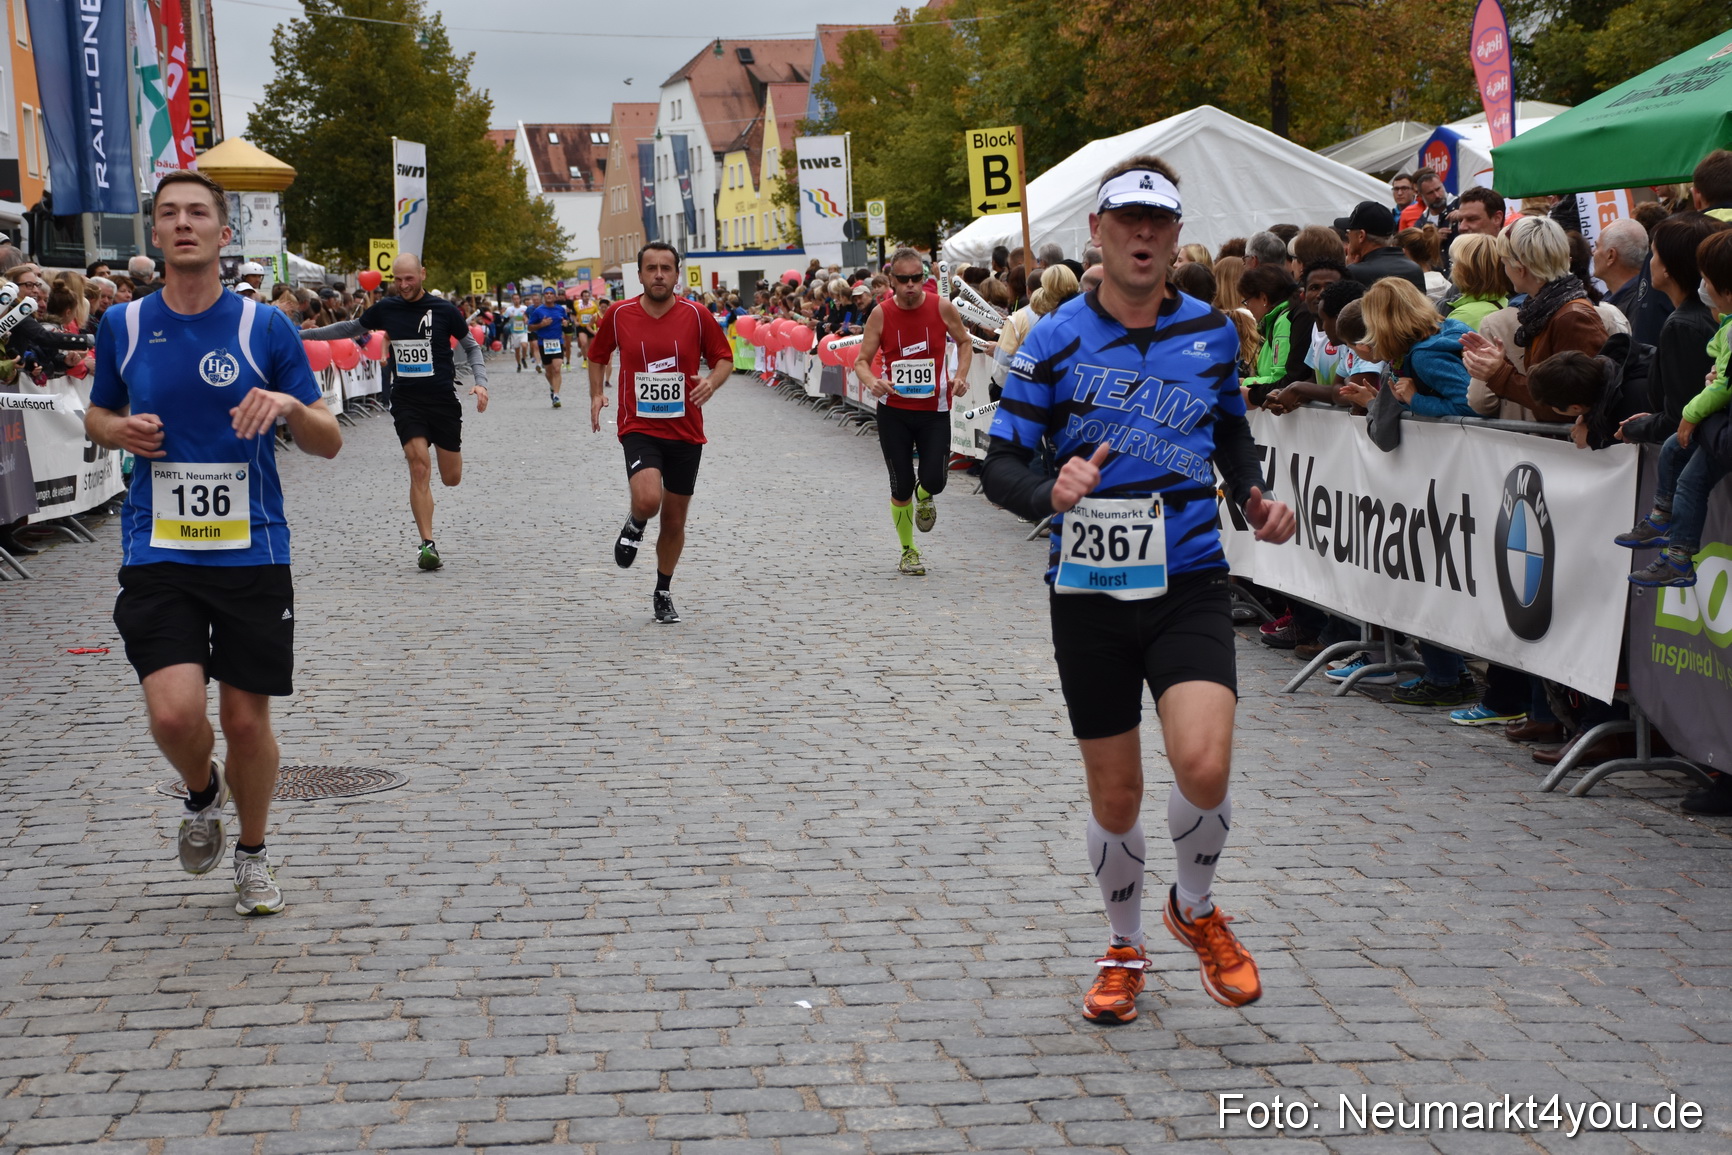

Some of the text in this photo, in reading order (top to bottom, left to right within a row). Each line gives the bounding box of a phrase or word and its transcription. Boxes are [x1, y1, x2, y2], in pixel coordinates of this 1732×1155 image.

[188, 70, 210, 145] HOT
[973, 130, 1017, 149] Block
[982, 154, 1012, 196] B
[373, 241, 394, 249] Block
[377, 252, 391, 271] C
[475, 279, 483, 289] D
[690, 271, 699, 283] D
[941, 276, 949, 293] BMW
[0, 315, 18, 334] BM
[397, 348, 428, 363] 2599
[896, 368, 932, 384] 2199
[640, 383, 681, 401] 2568
[906, 386, 922, 394] Peter
[6, 399, 55, 411] Laufsport
[1072, 363, 1208, 435] TEAM
[651, 404, 669, 412] Adolf
[154, 470, 232, 480] PARTL Neumarkt
[172, 484, 231, 517] 136
[1503, 468, 1549, 528] BMW
[1091, 510, 1144, 519] Neumarkt
[180, 525, 221, 538] Martin
[1290, 452, 1476, 598] Neumarkt
[1071, 521, 1153, 562] 2367
[1089, 571, 1128, 587] Horst
[1651, 634, 1713, 678] inspired
